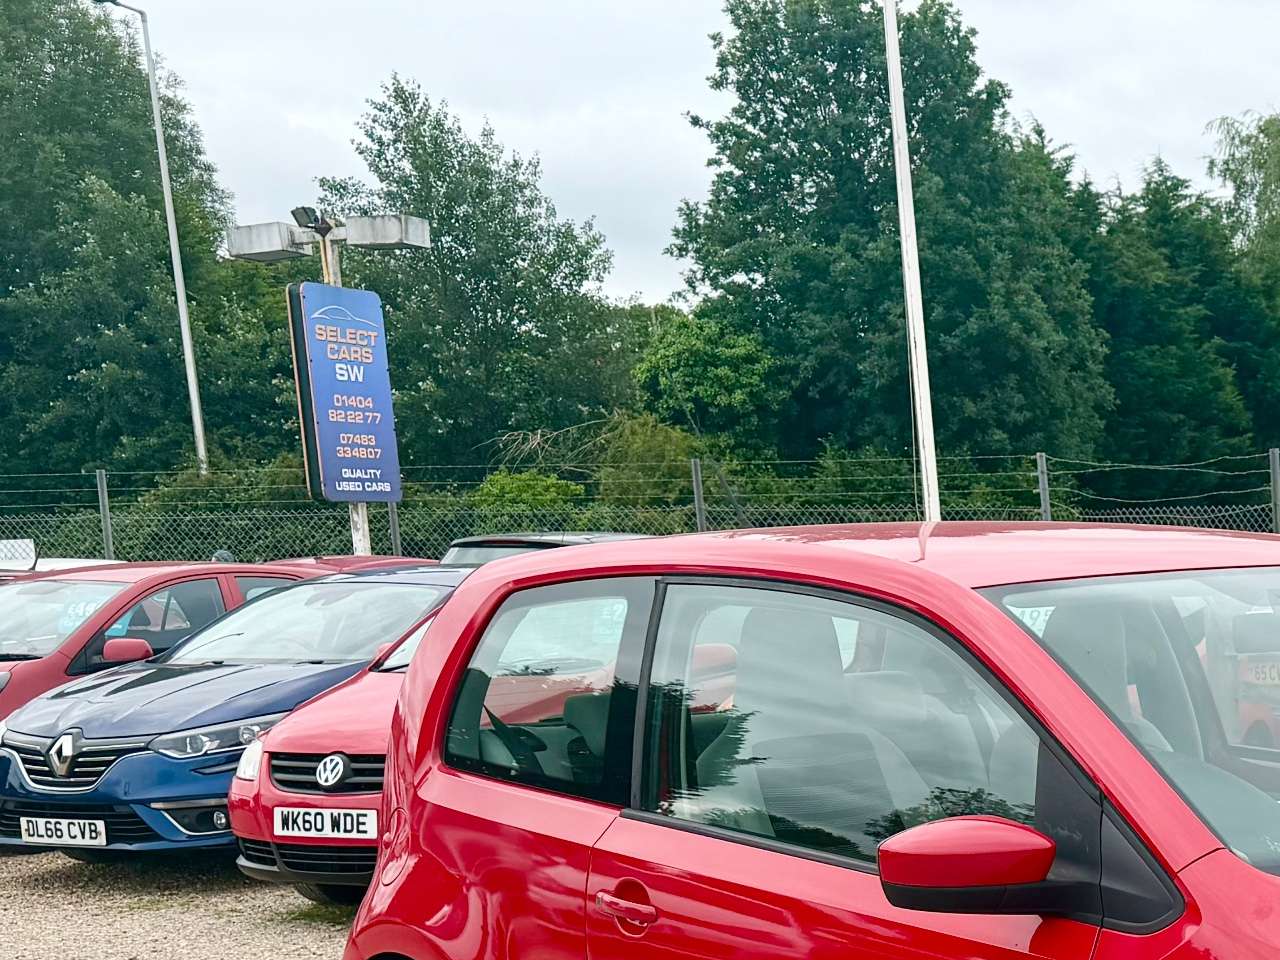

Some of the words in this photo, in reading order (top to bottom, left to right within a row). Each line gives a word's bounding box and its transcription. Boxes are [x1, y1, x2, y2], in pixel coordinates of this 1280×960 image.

[315, 324, 378, 347] SELECT
[327, 343, 374, 363] CARS
[335, 363, 364, 382] SW
[333, 394, 373, 409] 01404
[340, 433, 376, 446] 07483
[336, 446, 382, 459] 334807
[341, 468, 382, 479] QUALITY
[335, 481, 363, 491] USED
[364, 482, 391, 492] CARS
[26, 819, 64, 839] DL66
[67, 822, 99, 840] CVB
[281, 811, 325, 832] WK60
[331, 812, 368, 834] WDE
